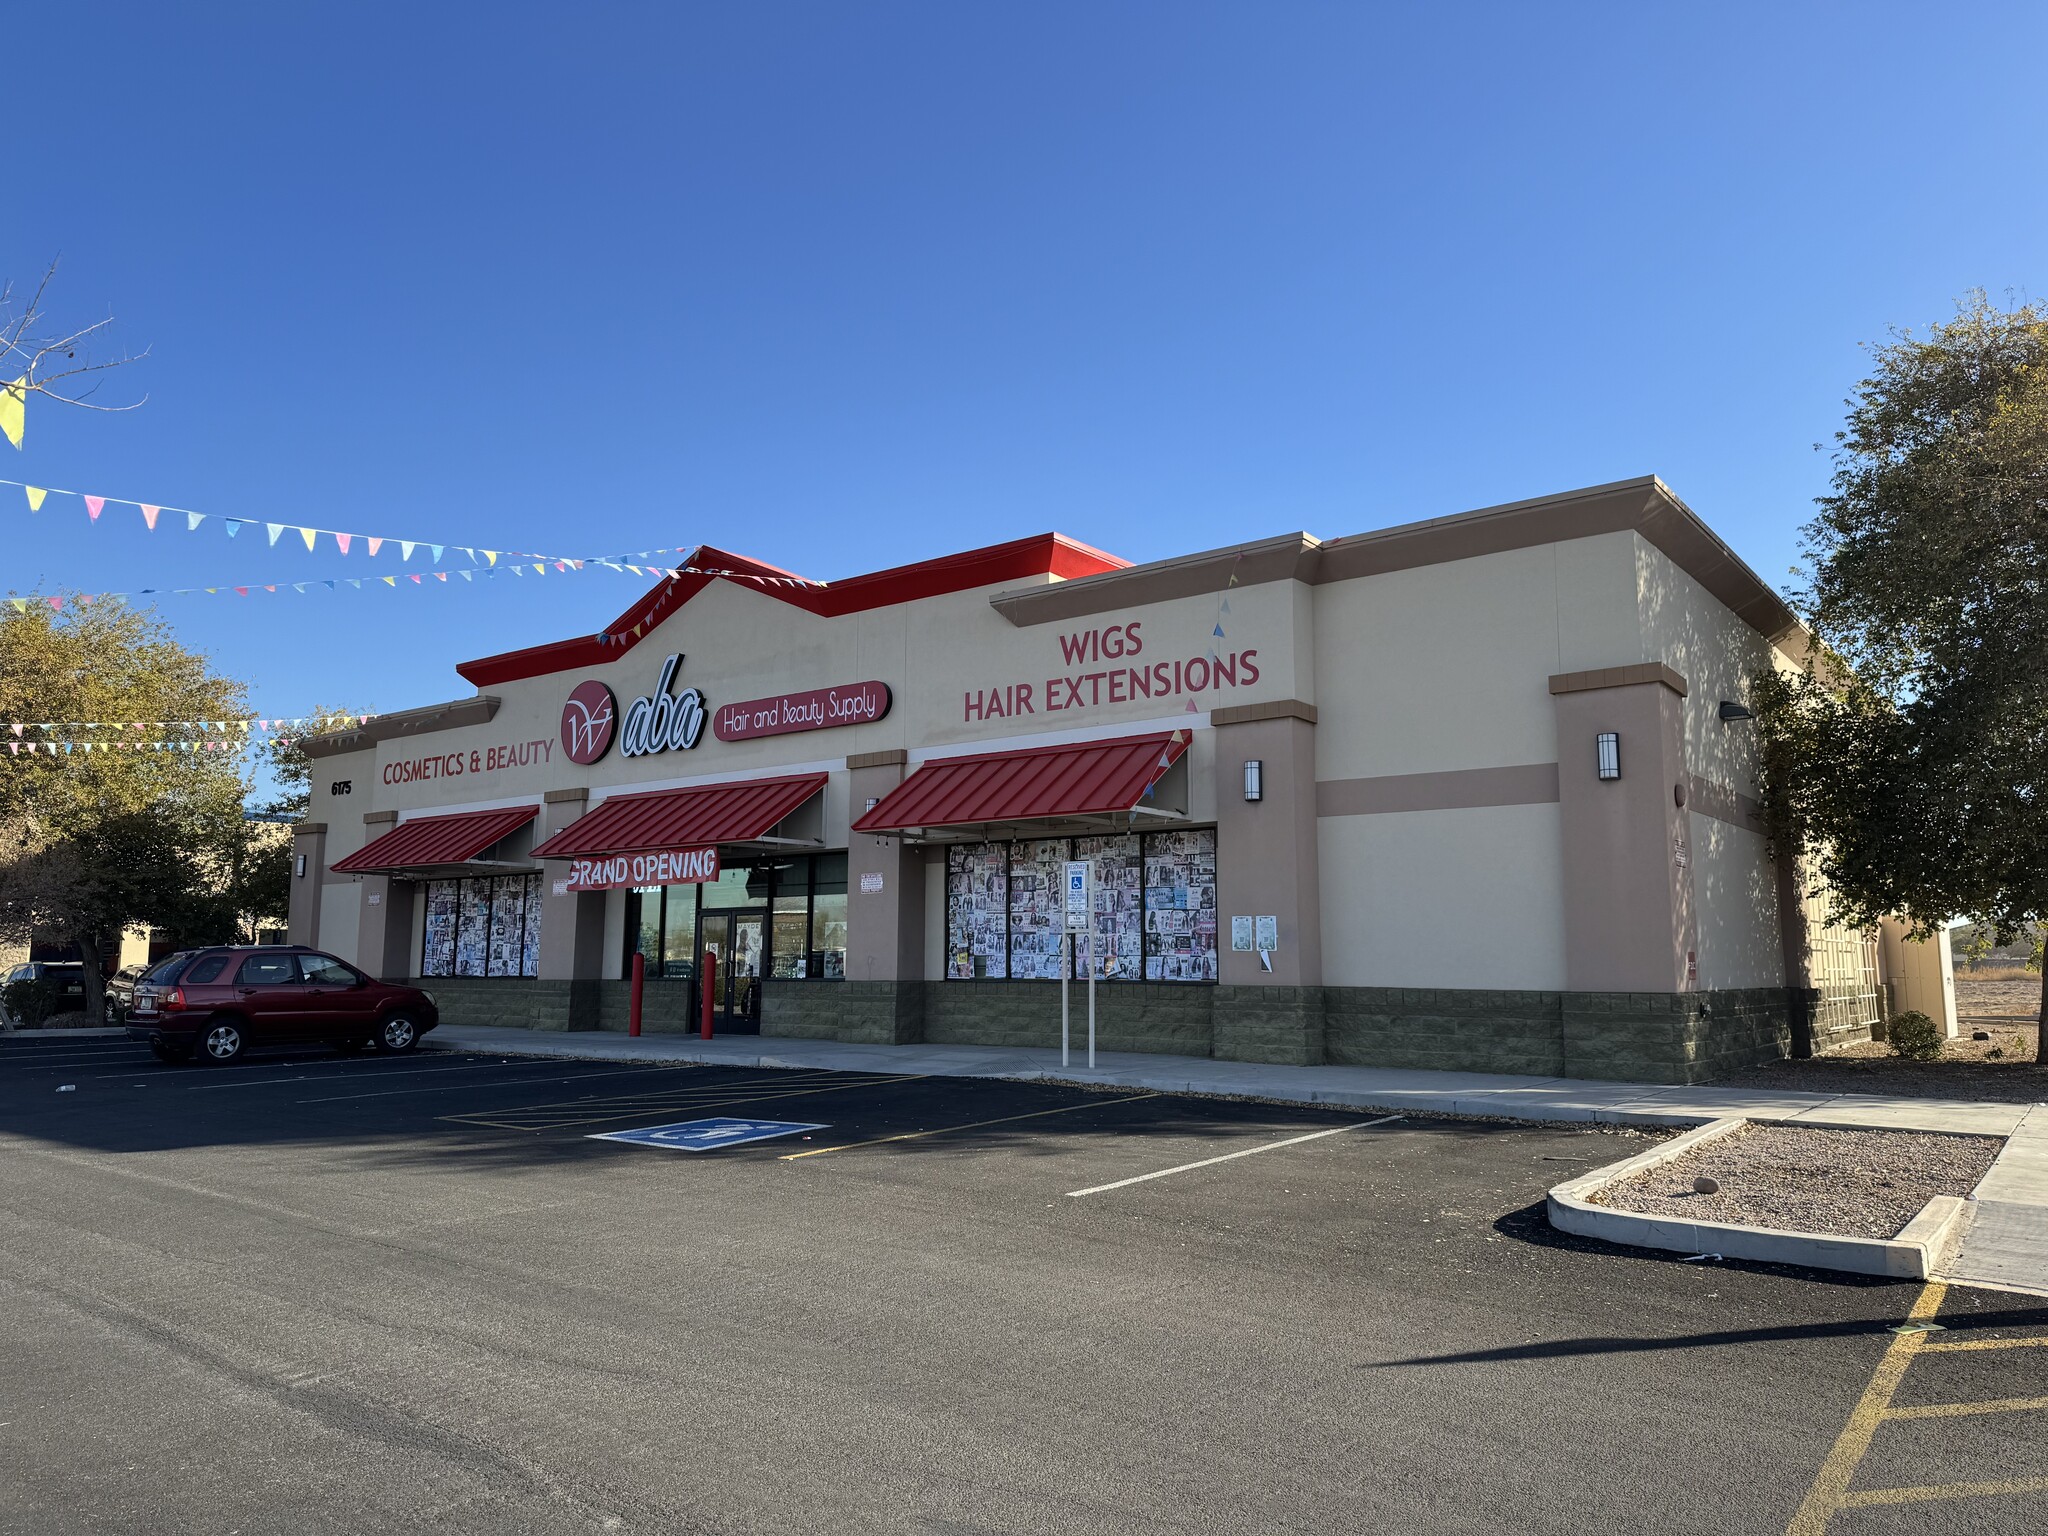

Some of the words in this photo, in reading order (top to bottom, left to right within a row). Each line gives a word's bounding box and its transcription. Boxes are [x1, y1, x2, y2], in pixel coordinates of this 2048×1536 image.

[1060, 622, 1143, 667] WIGS
[620, 653, 709, 758] aba
[964, 683, 1035, 722] HAIR
[1046, 649, 1260, 711] EXTENSIONS
[723, 707, 750, 733] Hair
[753, 700, 779, 729] and
[782, 698, 824, 726] Beauty
[828, 686, 876, 722] Supply
[383, 753, 465, 786] COSMETICS
[470, 750, 481, 773] &
[486, 738, 555, 771] BEAUTY
[331, 780, 353, 796] 6175
[633, 849, 716, 882] OPENING
